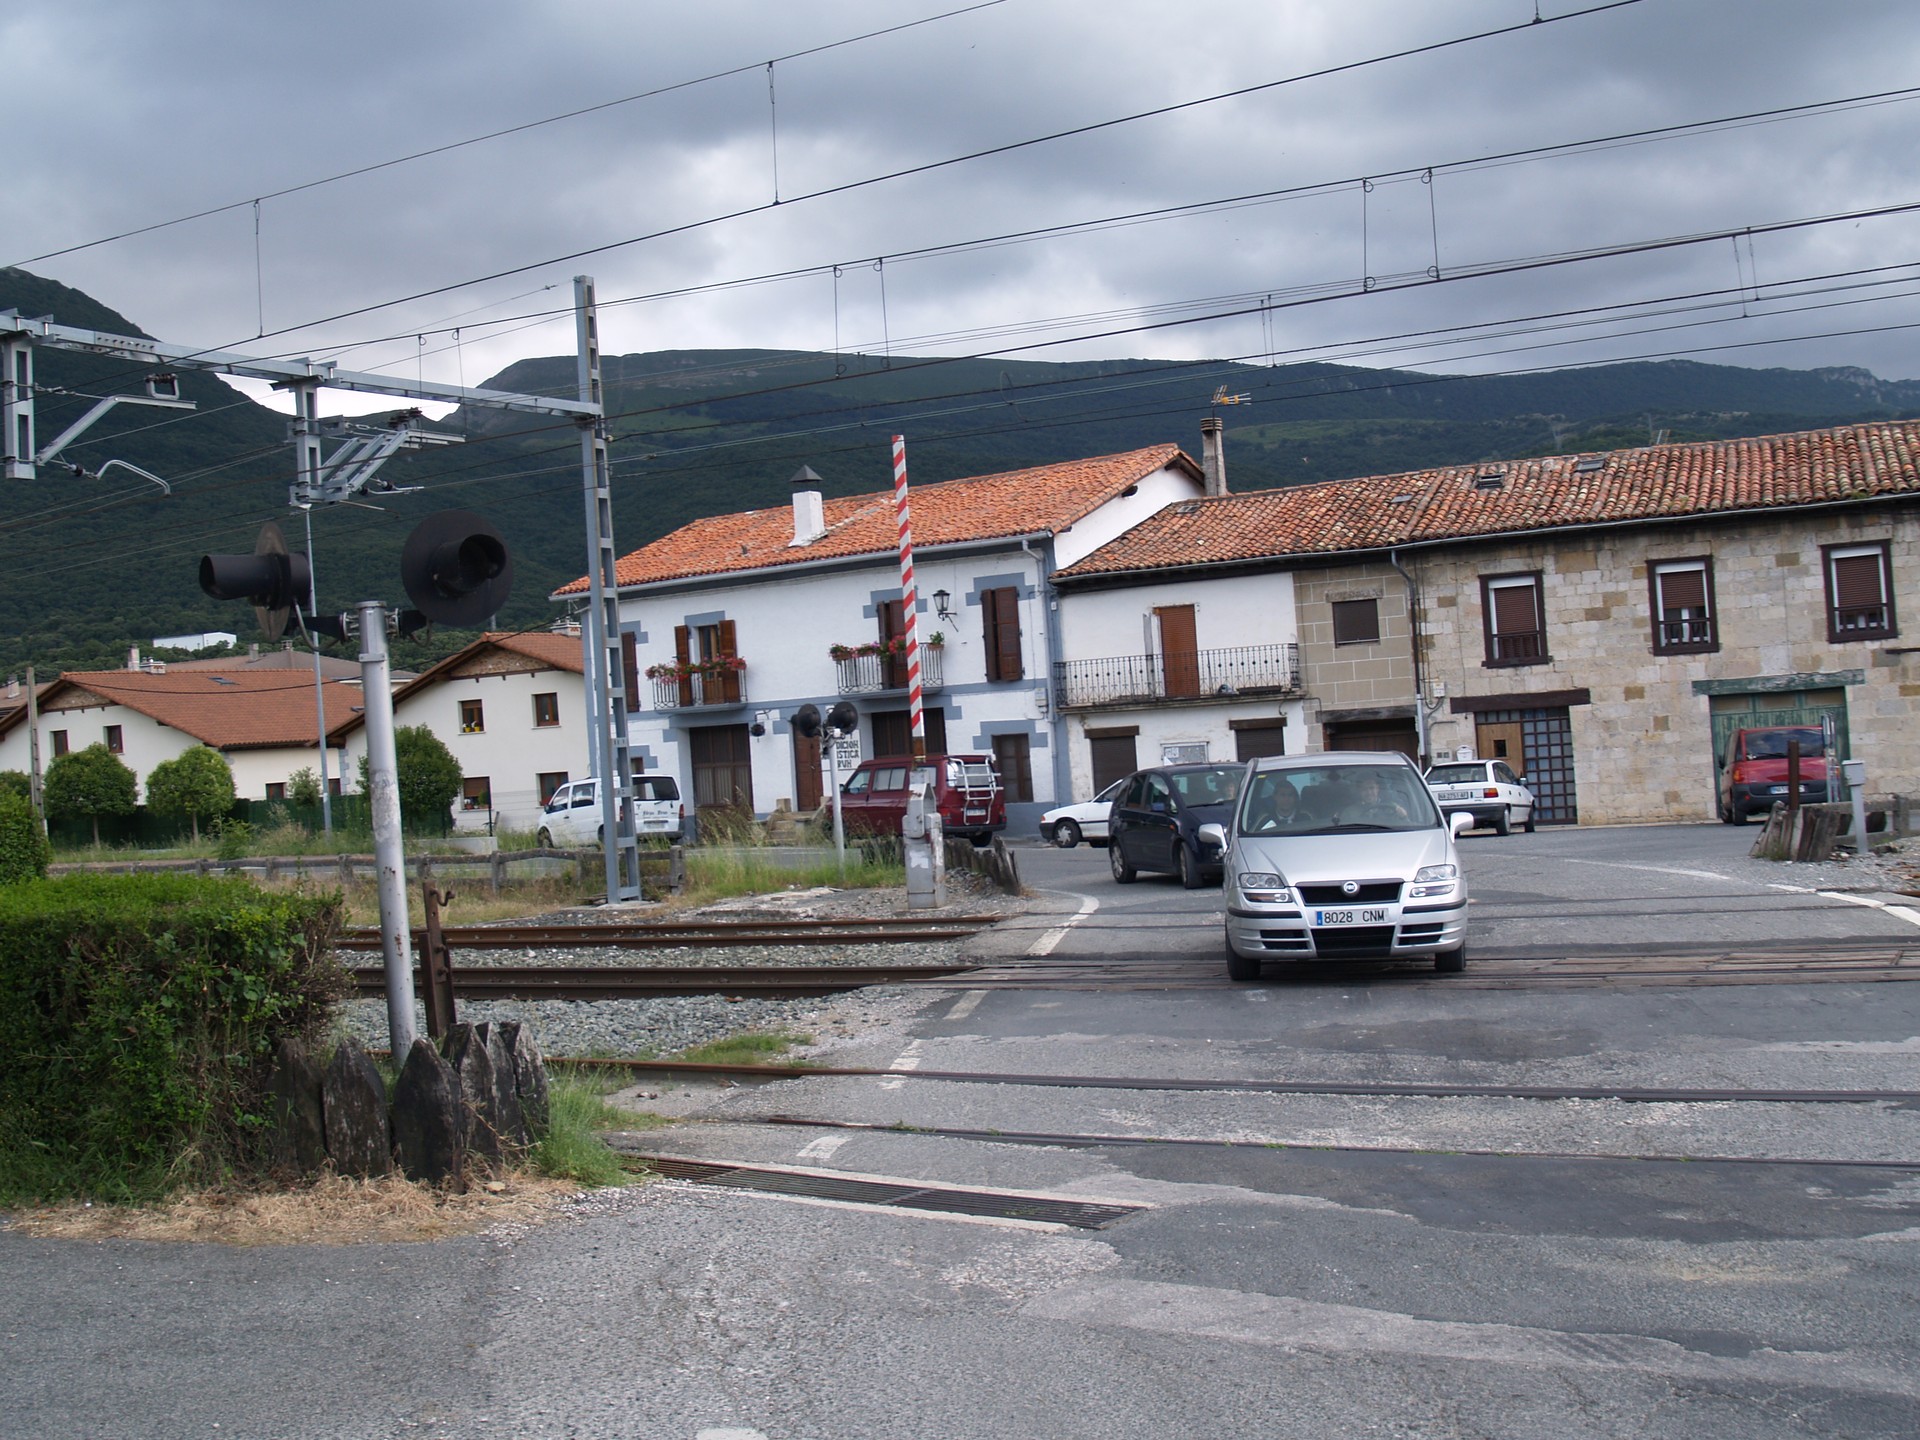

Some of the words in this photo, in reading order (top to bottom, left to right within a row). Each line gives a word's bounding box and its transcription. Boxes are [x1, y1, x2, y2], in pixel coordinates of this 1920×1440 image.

[836, 740, 859, 749] DICION
[836, 750, 859, 758] ISTICA
[1324, 911, 1353, 923] 8028
[1362, 910, 1385, 922] CNM
